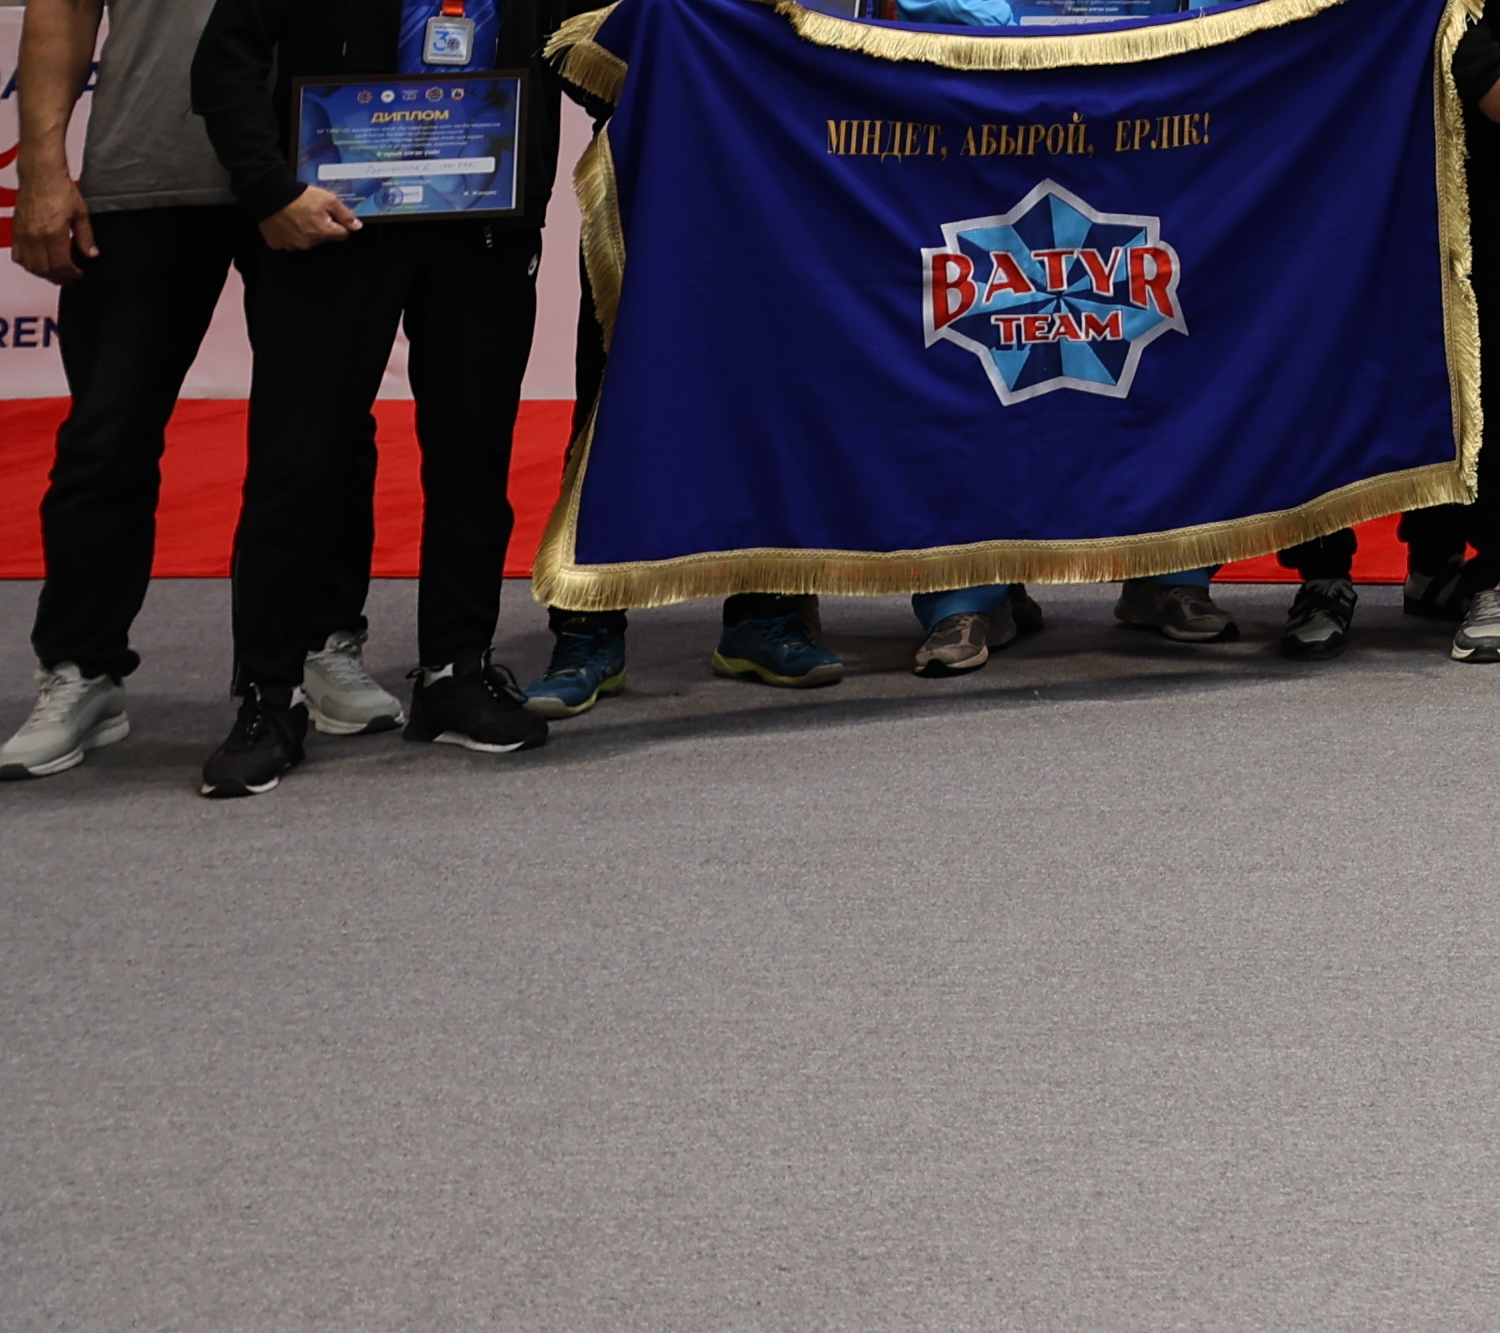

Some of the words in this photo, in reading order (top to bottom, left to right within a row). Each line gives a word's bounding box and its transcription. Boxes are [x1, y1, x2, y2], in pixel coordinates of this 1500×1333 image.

[371, 109, 450, 124] ДИПЛОМ
[825, 119, 949, 164] МІНДЕТ,
[960, 112, 1096, 159] АБЫРОЙ,
[1114, 112, 1212, 153] ЕРЛІК!
[930, 246, 1176, 331] BATYR
[990, 310, 1124, 346] TEAM
